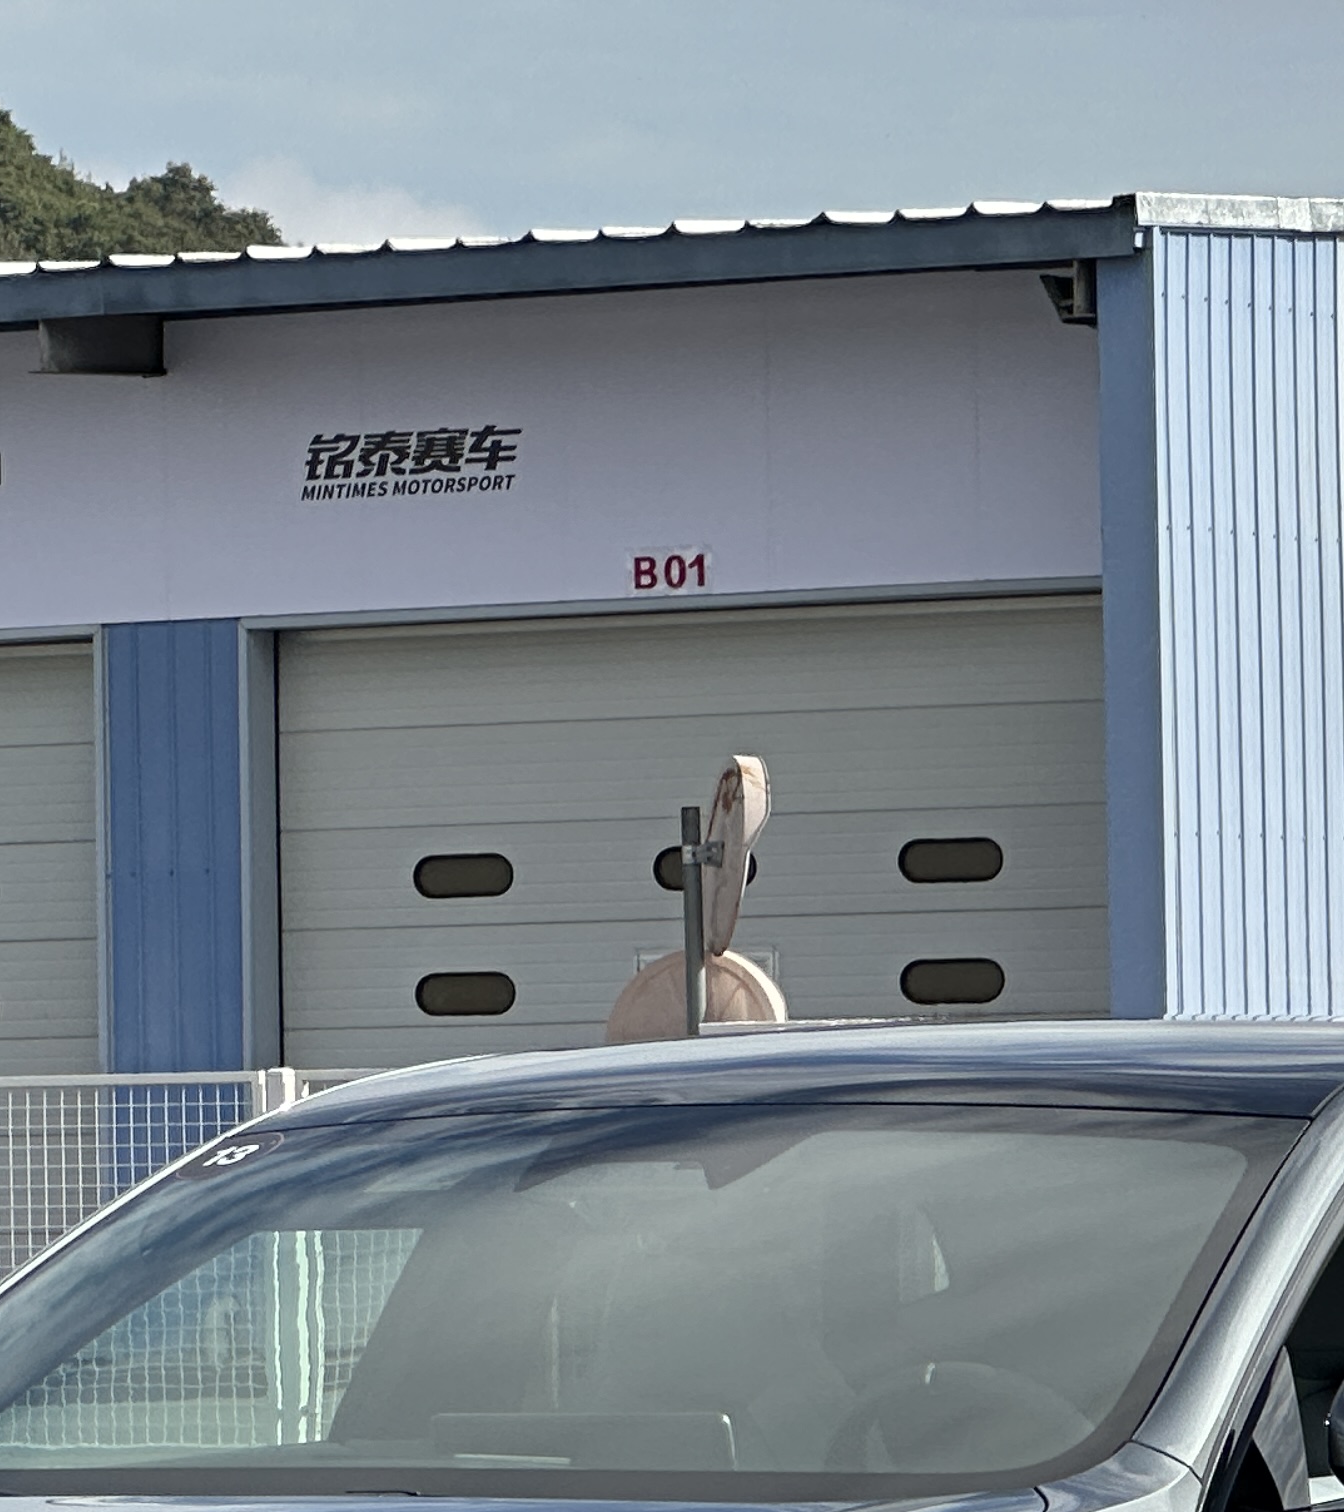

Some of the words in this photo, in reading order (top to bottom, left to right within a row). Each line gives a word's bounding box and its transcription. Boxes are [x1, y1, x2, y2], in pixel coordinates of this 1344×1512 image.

[305, 425, 523, 481] 铭泰赛车
[301, 481, 389, 501] MINTIMES
[392, 474, 516, 496] MOTORSPORT
[202, 1144, 260, 1167] 13
